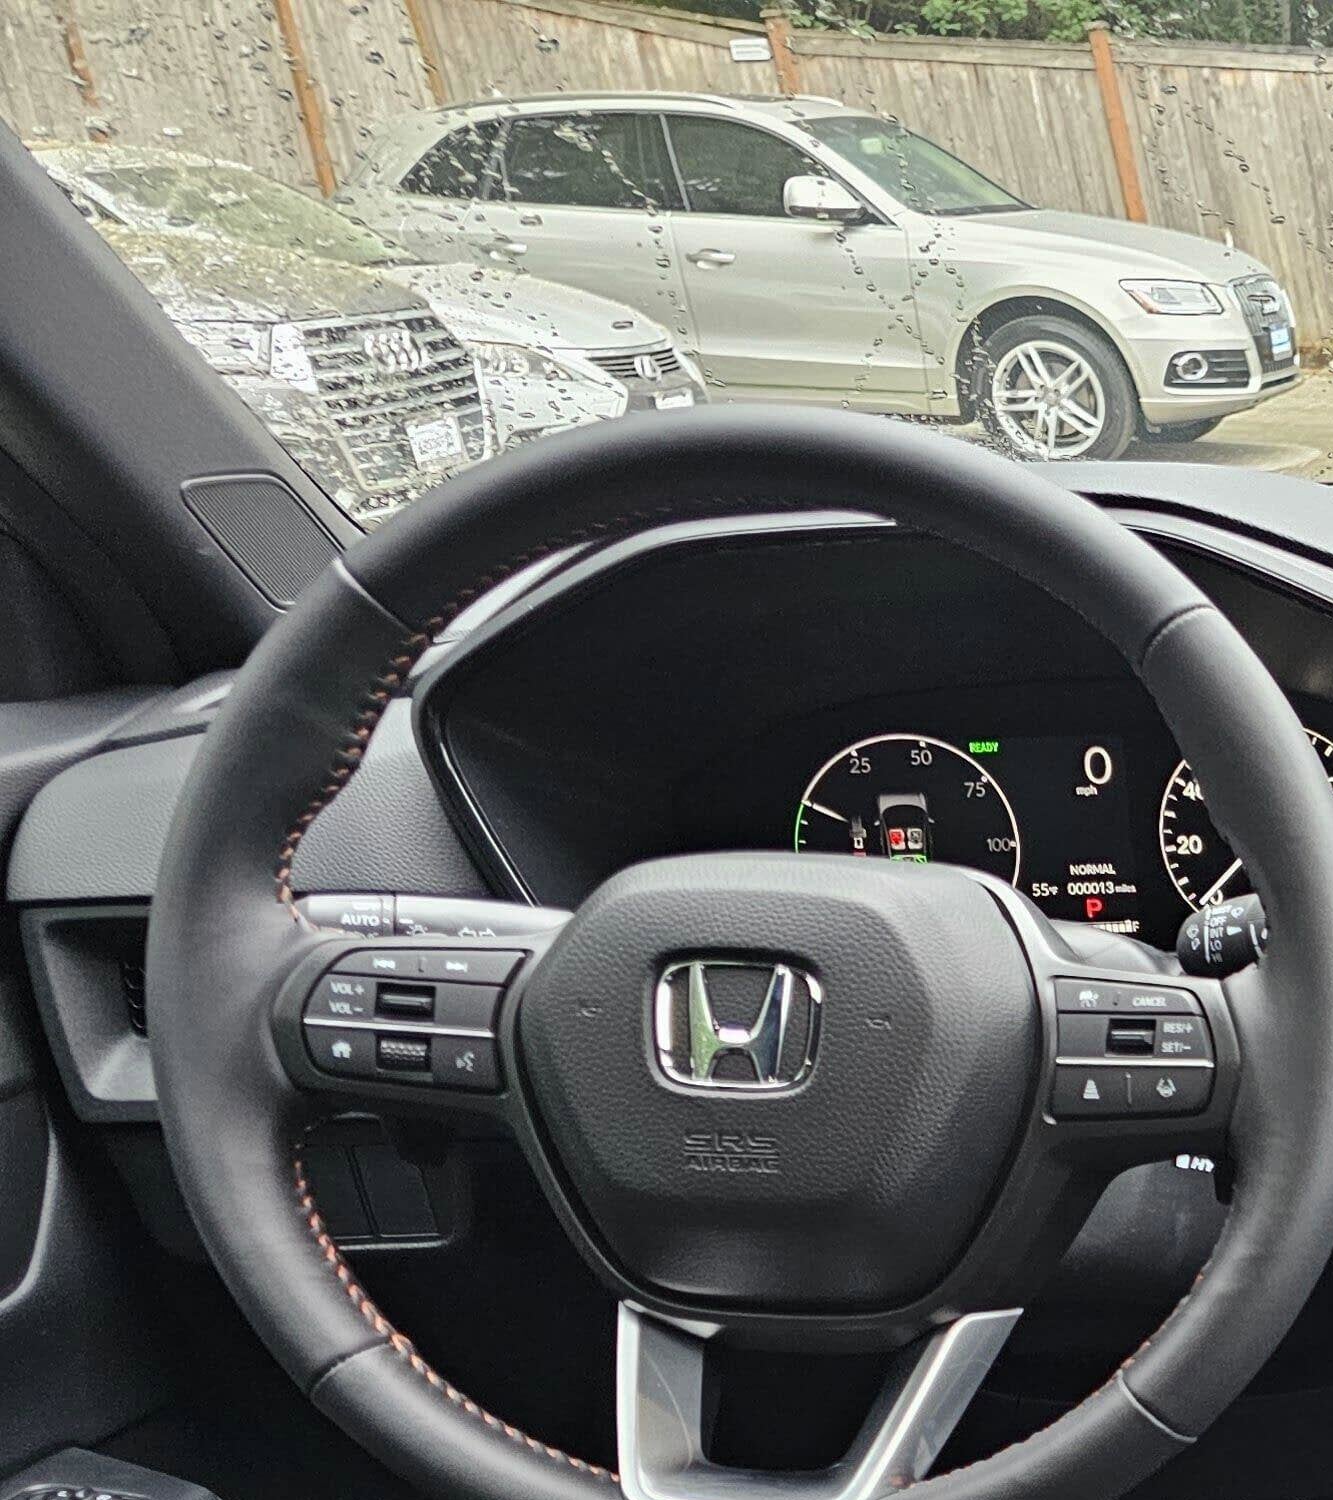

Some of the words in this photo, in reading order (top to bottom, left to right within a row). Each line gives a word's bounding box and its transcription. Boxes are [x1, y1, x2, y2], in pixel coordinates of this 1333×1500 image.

[969, 742, 999, 754] READY
[850, 758, 872, 774] 25
[910, 750, 933, 766] 50
[1083, 746, 1113, 785] 0
[963, 781, 987, 799] 75
[987, 837, 1012, 852] 100
[1176, 835, 1203, 855] 20
[1069, 863, 1116, 876] NORMAL
[1086, 898, 1103, 919] P
[340, 913, 380, 927] AUTO
[1132, 996, 1167, 1008] CANCEL
